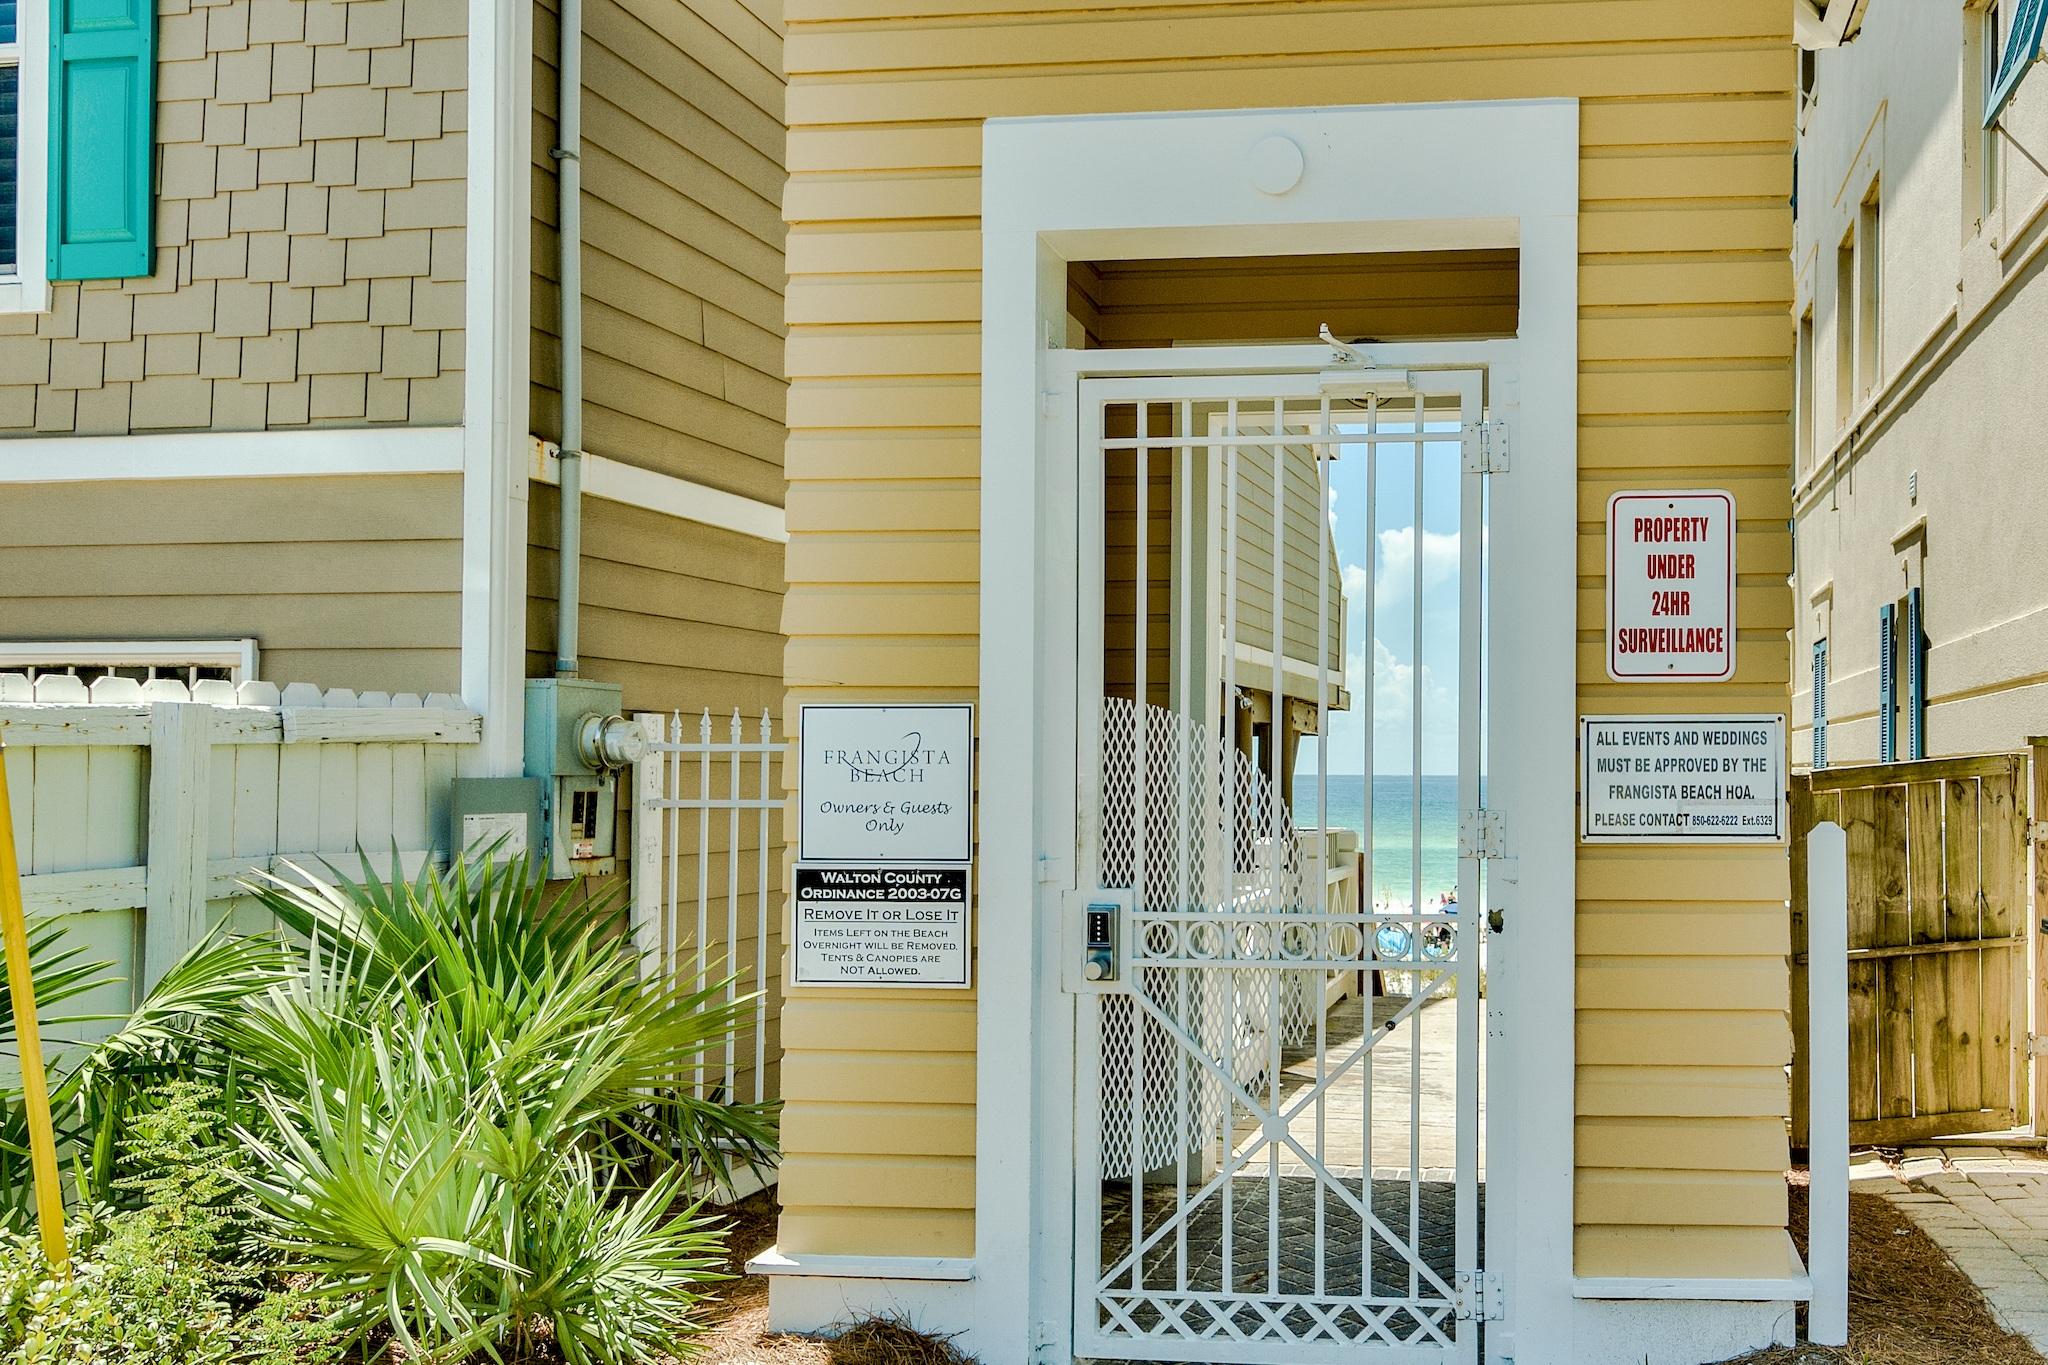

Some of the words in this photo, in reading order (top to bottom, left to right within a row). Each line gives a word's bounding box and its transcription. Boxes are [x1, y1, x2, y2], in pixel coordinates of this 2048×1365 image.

[1634, 517, 1709, 543] PROPERTY
[1647, 554, 1695, 580] UNDER
[1652, 591, 1690, 616] 24HR
[1618, 627, 1724, 653] SURVEILLANCE
[1596, 731, 1619, 746] ALL
[1622, 731, 1670, 746] EVENTS
[1673, 731, 1699, 746] AND
[1703, 731, 1768, 746] WEDDINGS
[824, 750, 950, 765] FRANGISTA
[1597, 758, 1631, 773] MUST
[1635, 758, 1650, 773] BE
[1654, 758, 1718, 772] APPROVED
[1722, 758, 1739, 772] BY
[1743, 758, 1767, 772] THE
[850, 768, 924, 783] BEACH
[1609, 785, 1677, 799] FRANGISTA
[1681, 785, 1722, 799] BEACH
[1726, 785, 1755, 799] HOA.
[820, 801, 880, 814] Owners
[883, 801, 895, 815] &
[900, 801, 952, 815] Guests
[865, 818, 904, 835] Only
[1595, 813, 1636, 826] PLEASE
[1639, 813, 1690, 826] CONTACT
[1692, 815, 1738, 826] 850-622-6222
[820, 871, 881, 884] WALTON
[884, 872, 942, 884] COUNTY
[800, 887, 885, 899] ORDINANCE
[804, 908, 863, 920] REMOVE
[866, 909, 879, 920] IT
[882, 911, 902, 920] OR
[906, 909, 942, 921] LOSE
[947, 909, 959, 921] IT
[814, 928, 844, 937] ITEMS
[846, 928, 872, 937] LEFT
[913, 929, 948, 938] BEACH
[803, 941, 861, 949] OVERNIGHT
[864, 942, 888, 950] WILL
[891, 942, 904, 950] BE
[906, 941, 958, 951] REMOVED.
[821, 953, 853, 962] TENTS
[856, 953, 863, 962] &
[866, 953, 918, 962] CANOPIES
[920, 955, 941, 963] ARE
[840, 966, 865, 975] NOT
[867, 966, 921, 975] ALLOWED.
